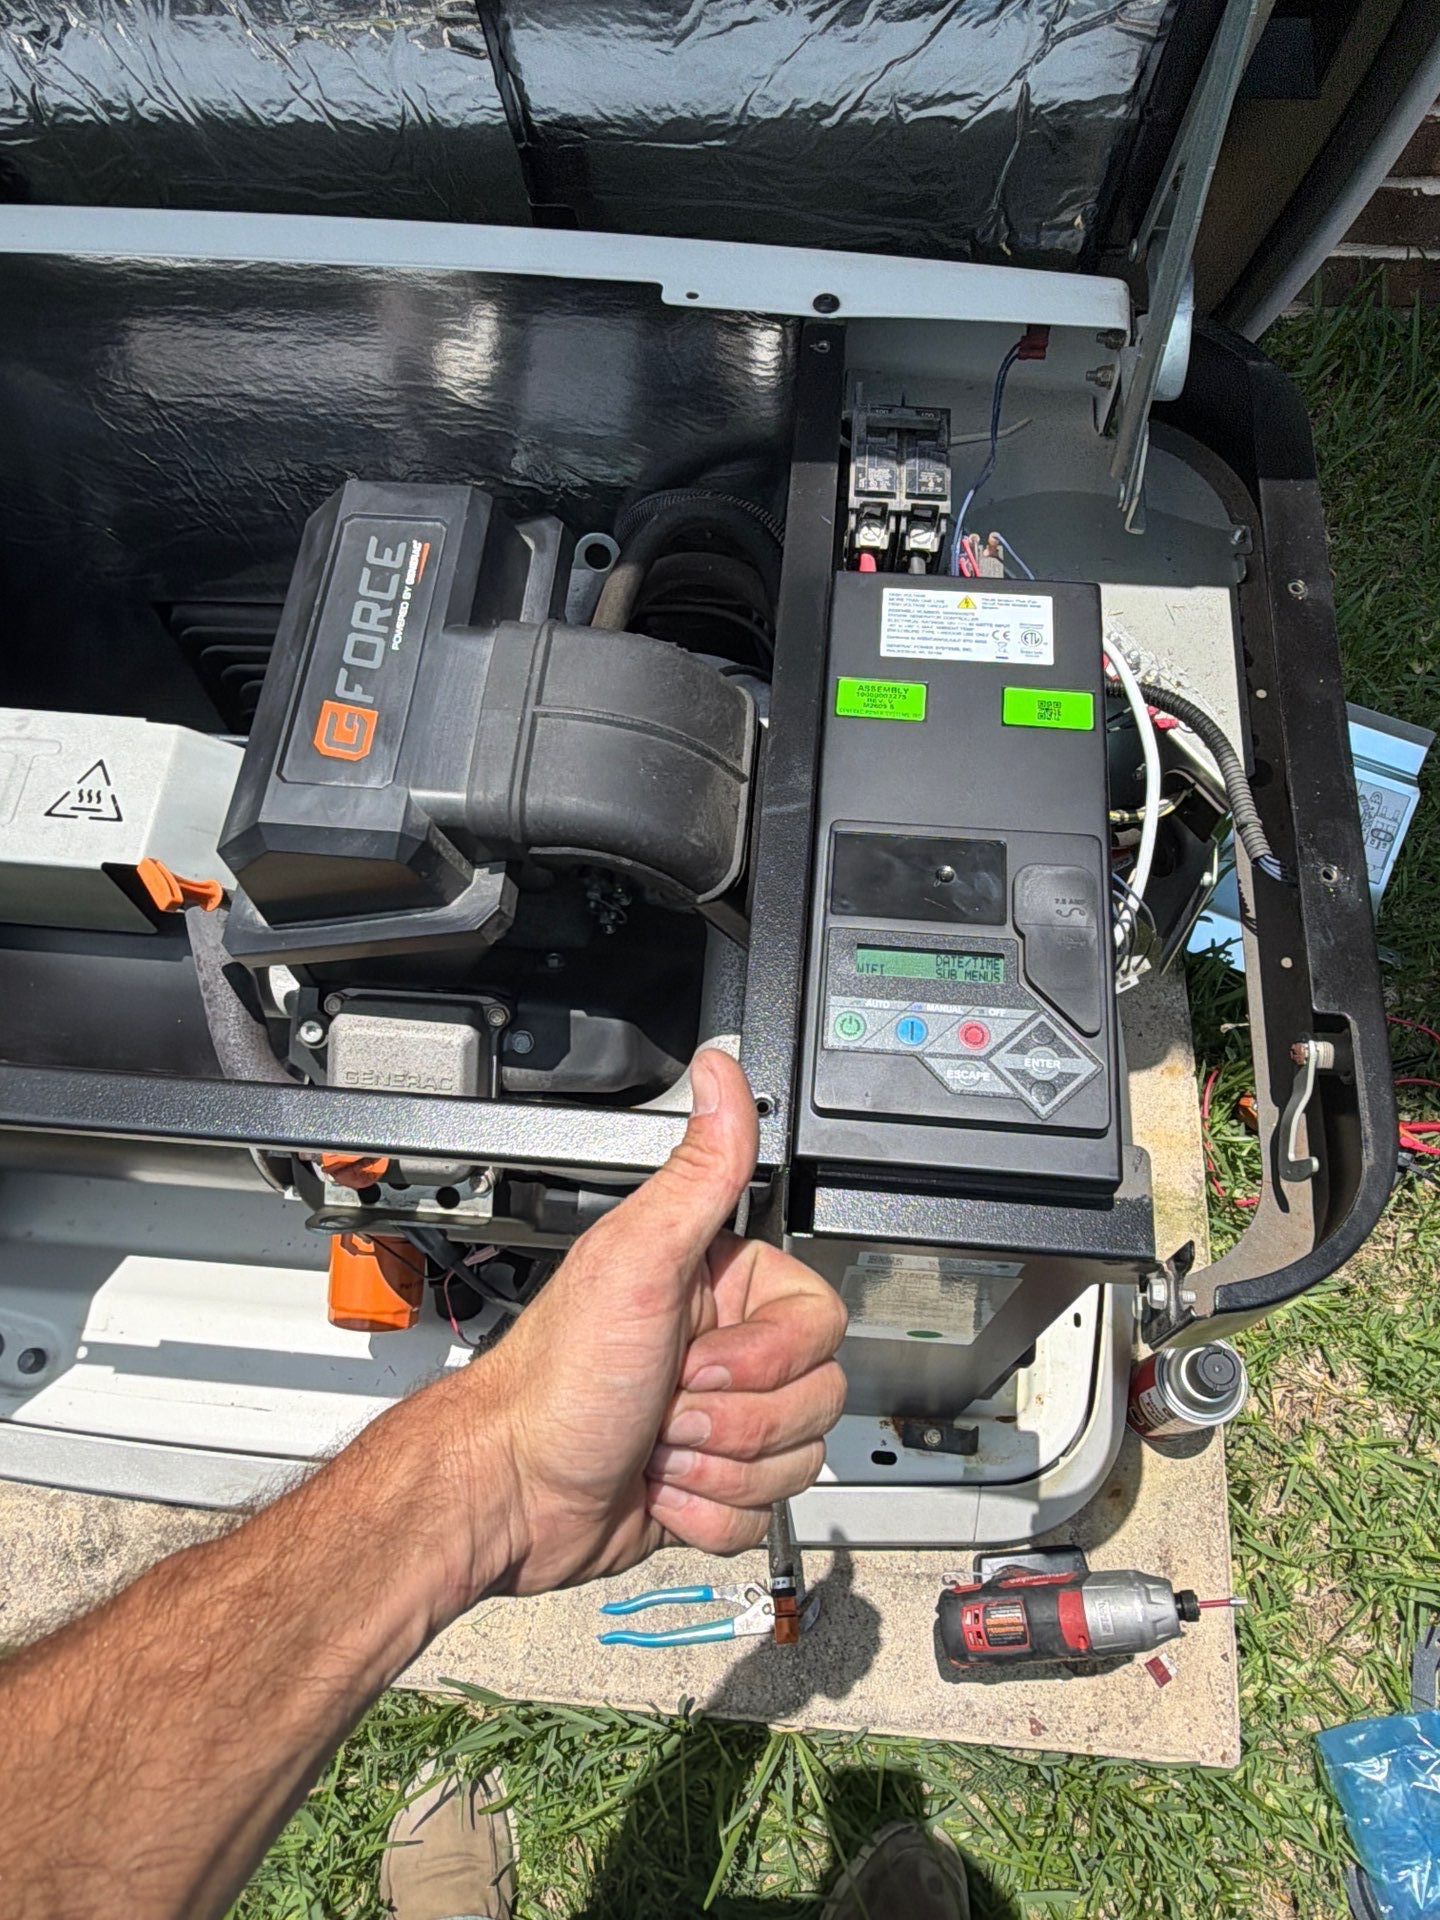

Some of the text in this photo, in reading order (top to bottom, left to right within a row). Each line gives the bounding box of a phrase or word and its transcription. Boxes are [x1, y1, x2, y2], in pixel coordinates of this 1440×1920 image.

[335, 535, 407, 704] FORCE
[392, 601, 409, 651] POWERED
[402, 585, 412, 600] BY
[857, 684, 909, 695] ASSEMBLY
[857, 963, 885, 975] WIFI
[936, 955, 1000, 971] DATE/TIME
[936, 967, 1001, 983] SUB MENUS
[865, 1000, 891, 1010] AUTO
[926, 1002, 964, 1014] MANUAL
[988, 1007, 1006, 1017] OFF
[1024, 1057, 1061, 1070] ENTER
[344, 1069, 454, 1092] GENERAC
[946, 1068, 991, 1082] ESCAPE
